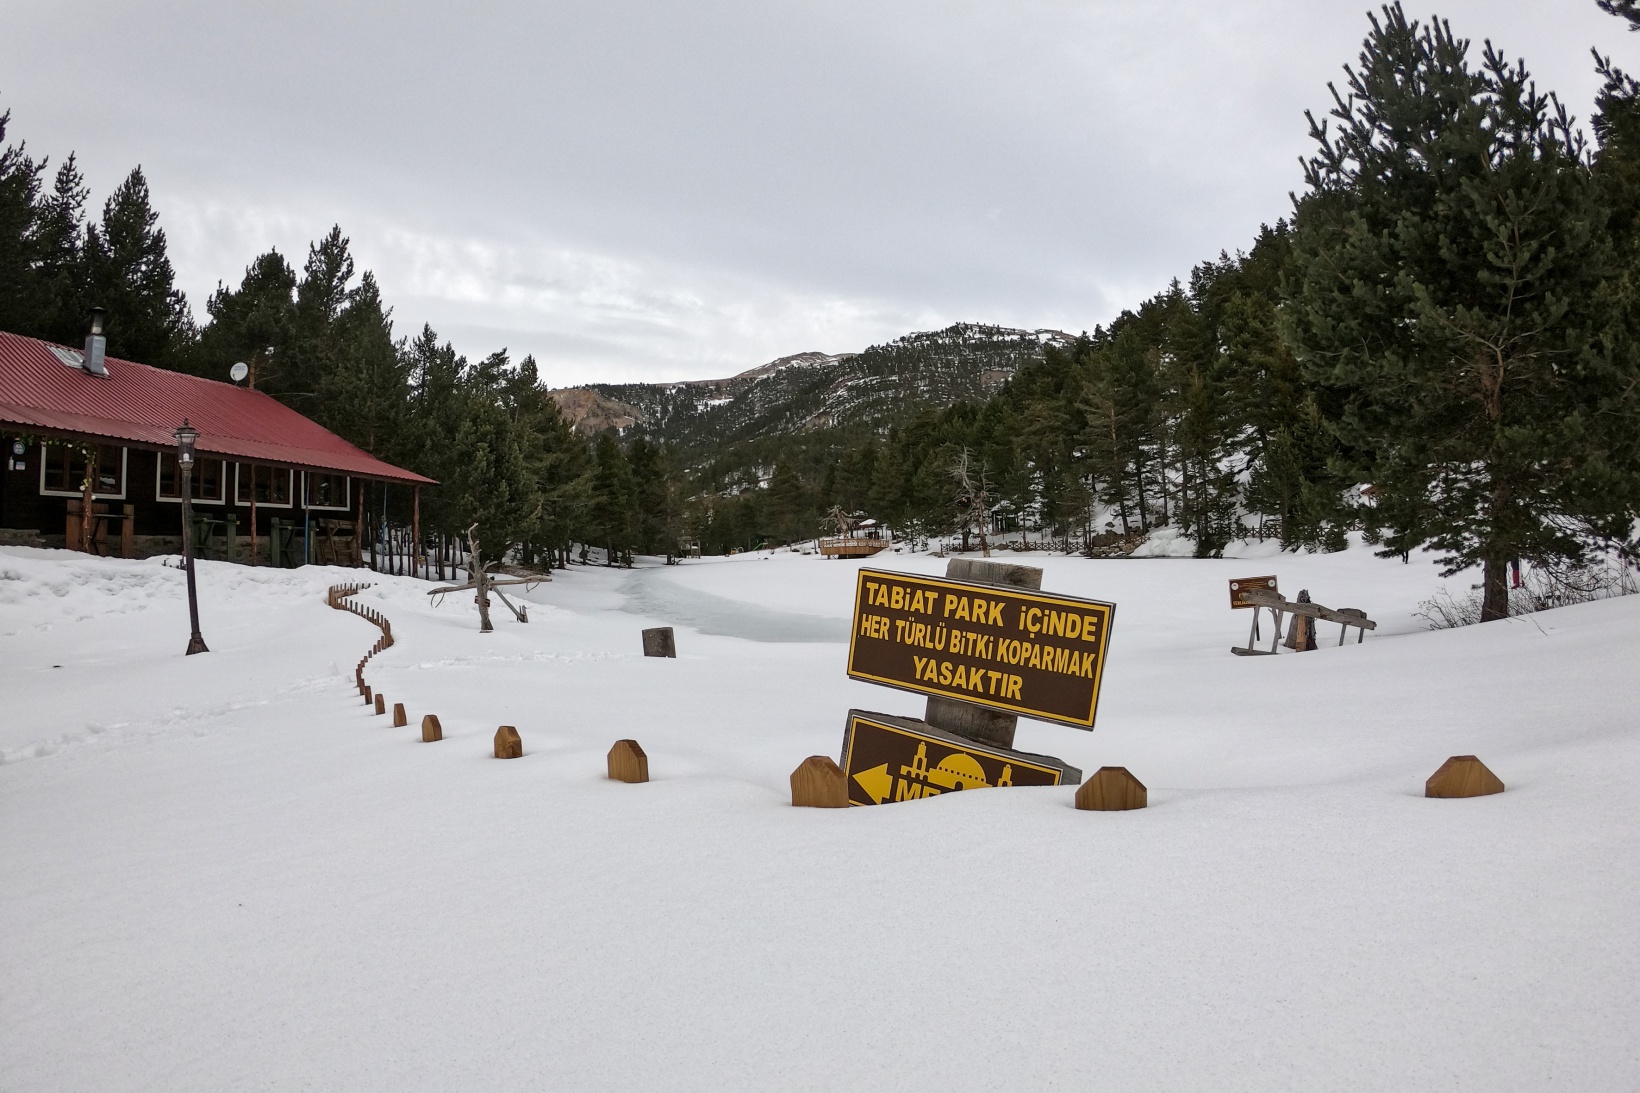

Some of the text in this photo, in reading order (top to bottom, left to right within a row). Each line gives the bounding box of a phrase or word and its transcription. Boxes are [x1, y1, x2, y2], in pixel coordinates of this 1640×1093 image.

[943, 593, 1006, 627] PARK
[860, 613, 890, 641] HER
[895, 616, 947, 652] TÜRLÜ
[996, 637, 1097, 679] KOPARMAK
[912, 655, 1024, 701] YASAKTIR
